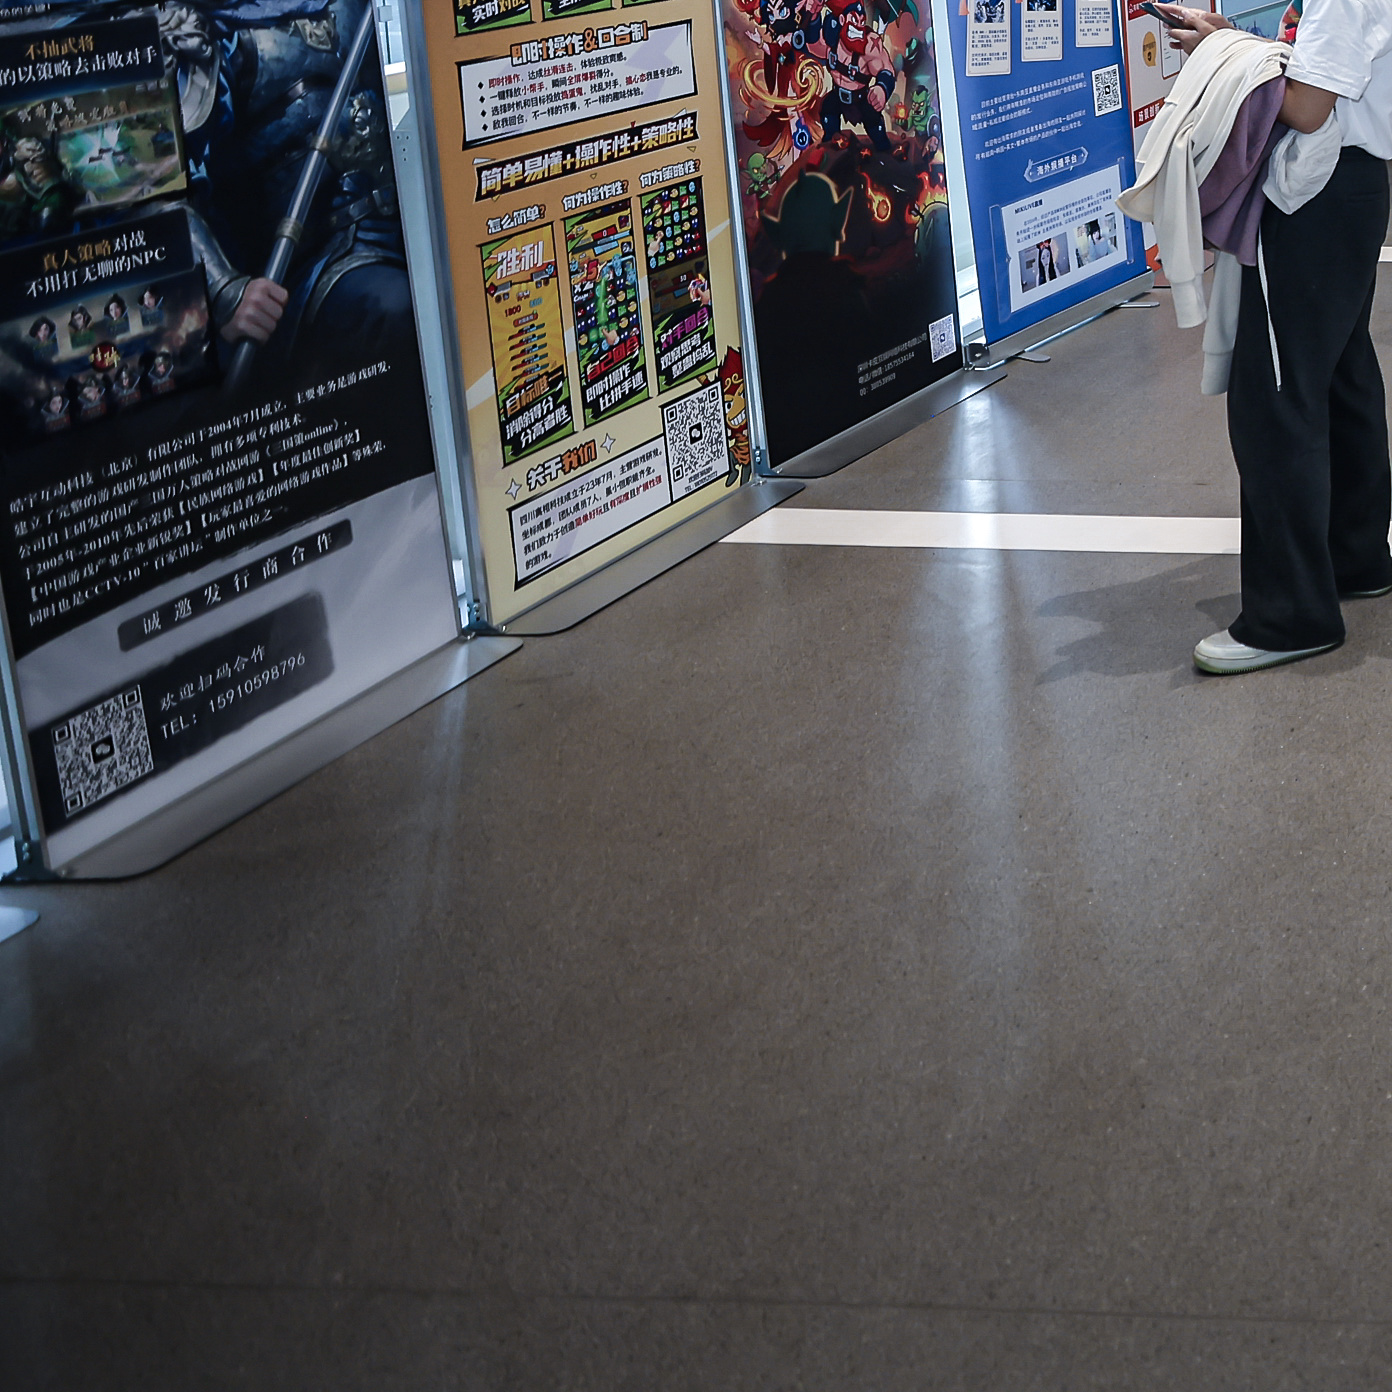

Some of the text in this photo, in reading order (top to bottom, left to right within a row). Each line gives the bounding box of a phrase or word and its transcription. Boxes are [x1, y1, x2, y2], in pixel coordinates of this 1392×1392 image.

[25, 35, 95, 59] 不抽武将
[511, 22, 648, 66] 即时操作&回合制
[481, 117, 694, 195] 简单易懂+操作性+策略性
[26, 247, 167, 298] 不用打无聊的NPC
[43, 230, 147, 272] 真人策略对战
[497, 241, 544, 279] 胜利
[600, 371, 644, 411] 比拼手速
[506, 396, 554, 439] 消除得分
[521, 404, 569, 448] 分高者胜
[526, 440, 597, 491] 关于我们
[143, 532, 332, 634] 诚邀发行商合作
[209, 652, 306, 714] 15910598796
